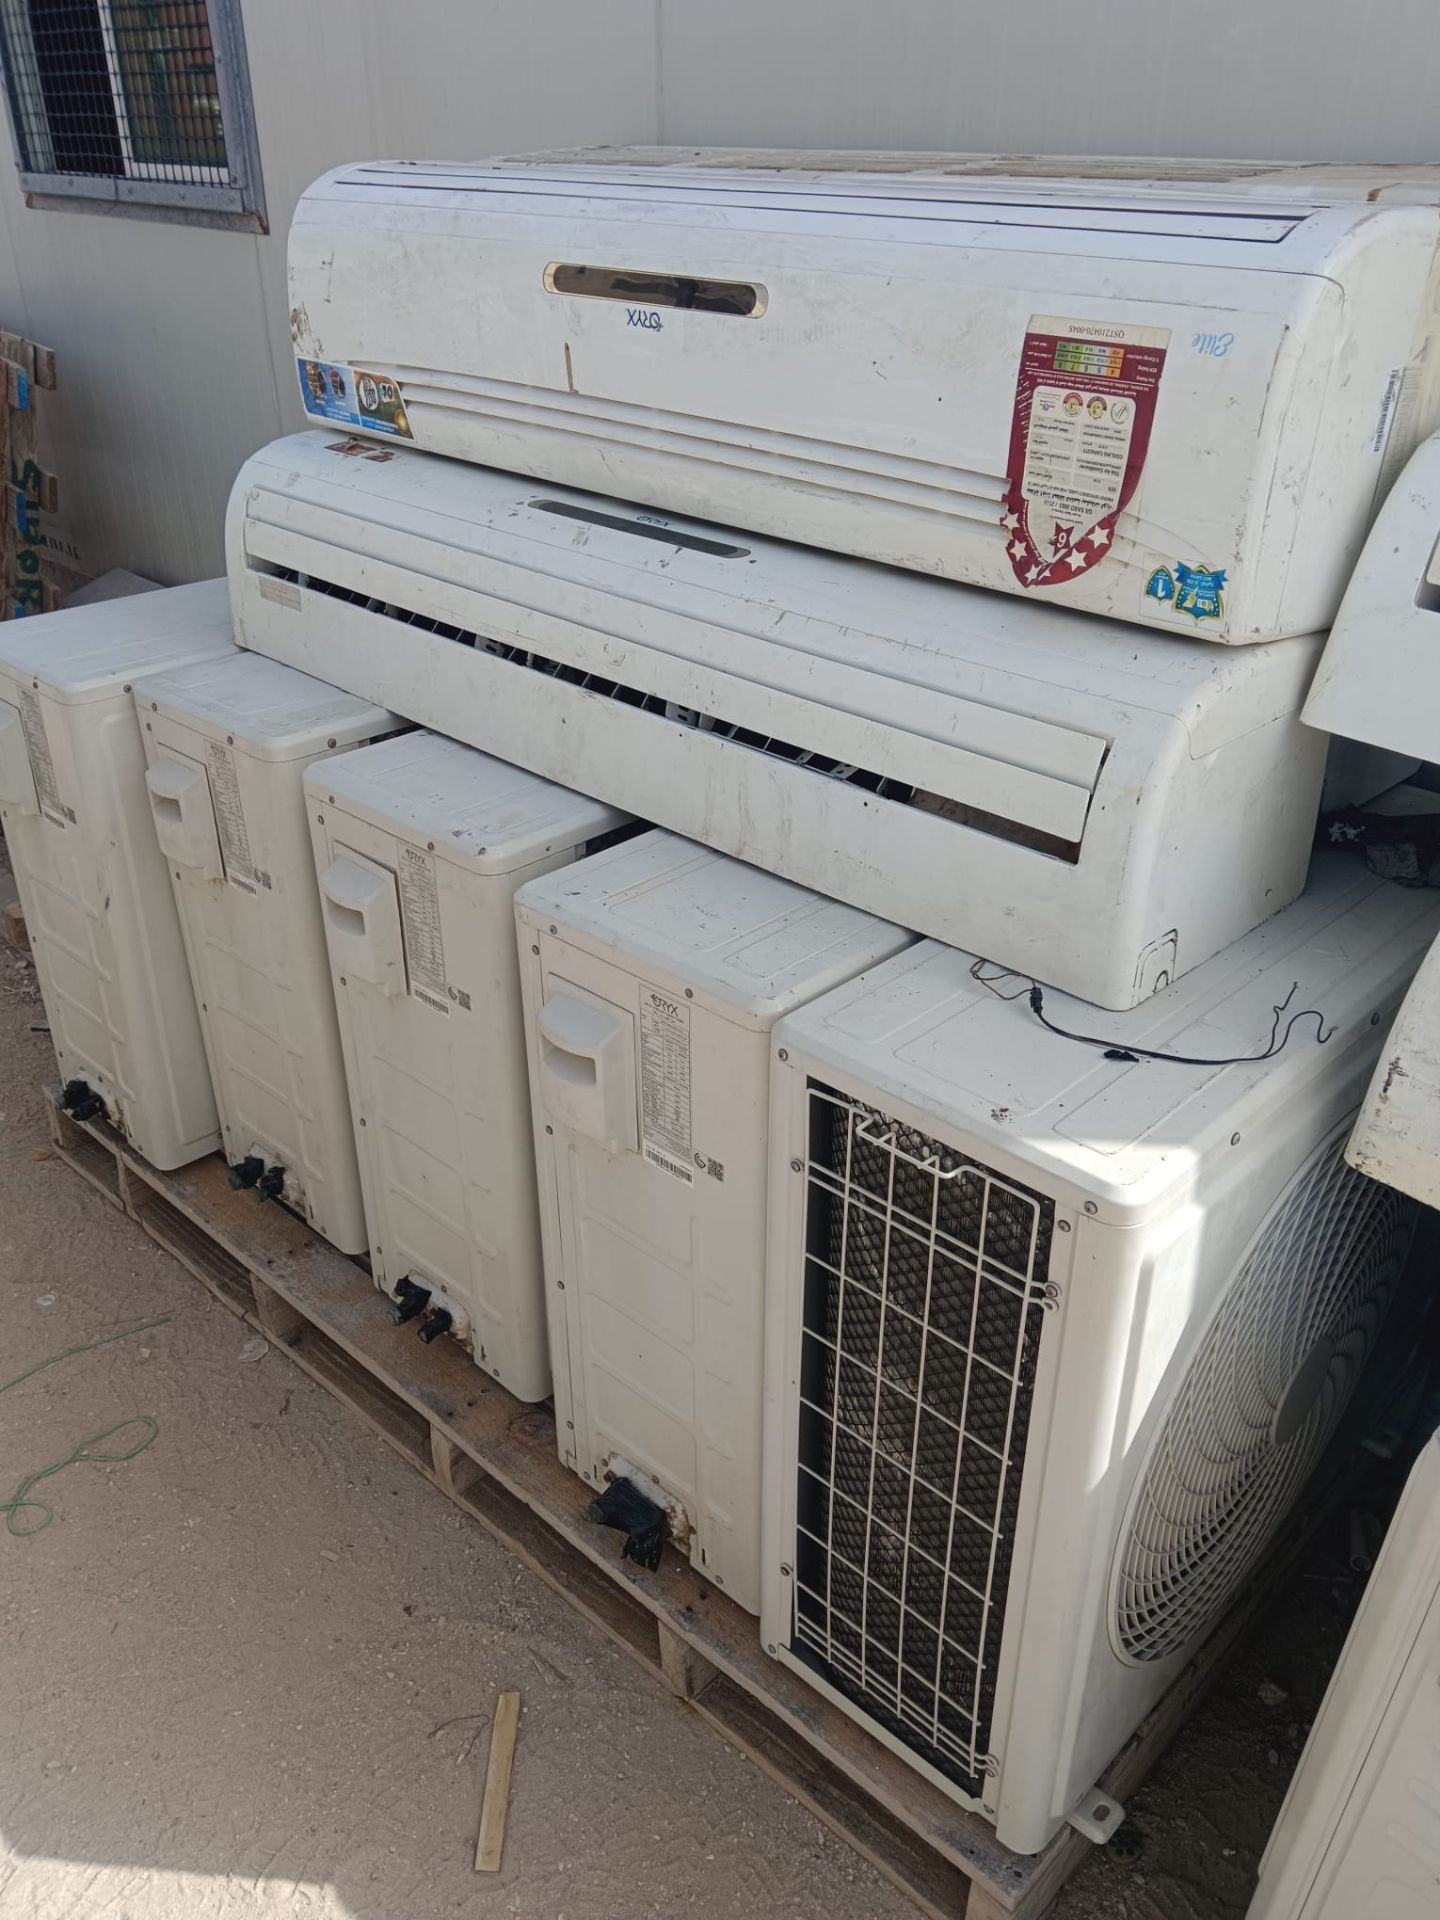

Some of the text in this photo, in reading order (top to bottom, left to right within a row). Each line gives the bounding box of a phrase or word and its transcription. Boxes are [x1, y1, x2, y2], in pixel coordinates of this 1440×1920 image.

[627, 309, 664, 332] ORYX
[1191, 332, 1235, 358] Elite
[1057, 532, 1067, 548] 6
[1157, 579, 1166, 598] 1
[650, 994, 679, 1017] ORYX
